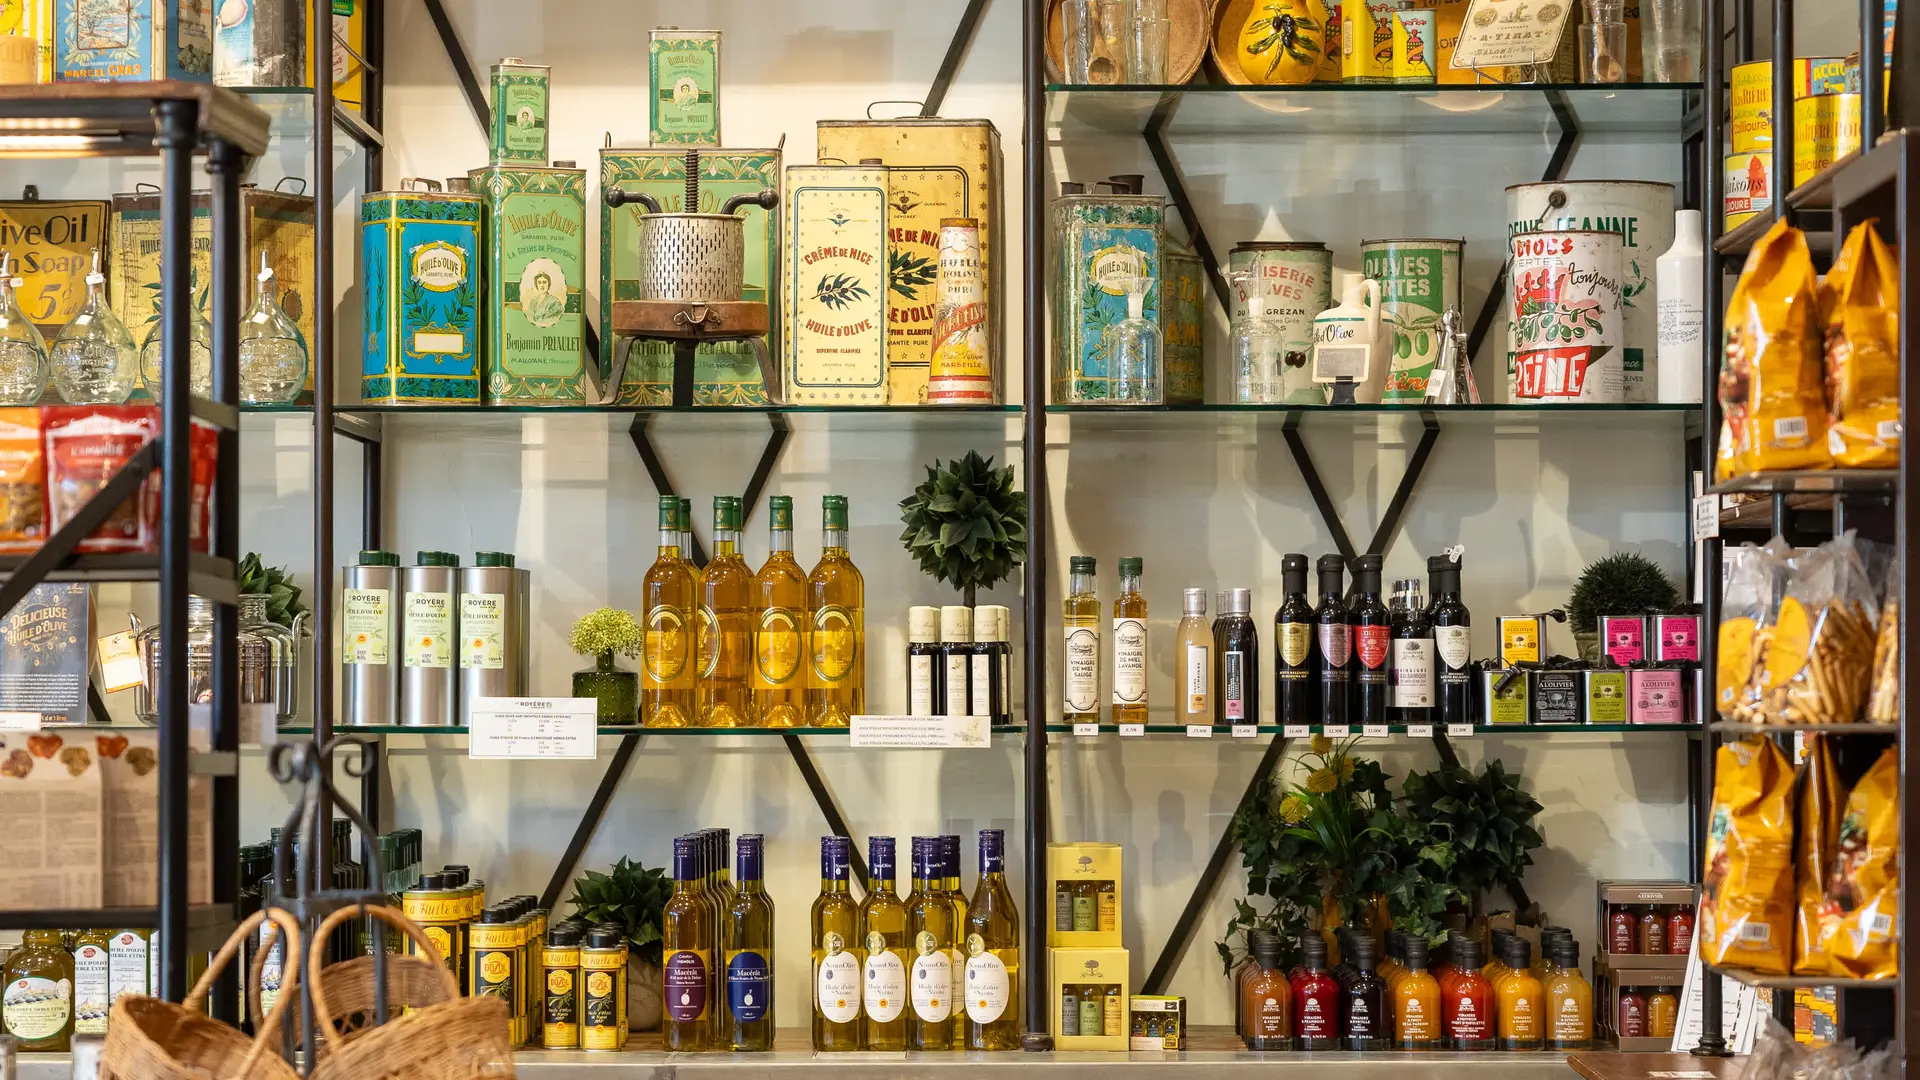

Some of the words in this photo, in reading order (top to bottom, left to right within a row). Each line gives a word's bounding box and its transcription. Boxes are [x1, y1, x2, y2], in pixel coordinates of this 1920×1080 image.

[64, 69, 105, 78] MARCEL
[108, 64, 142, 76] GRAS
[44, 214, 88, 245] Oil
[508, 212, 540, 235] HUILE
[905, 229, 917, 243] DE
[24, 251, 84, 276] Soap
[420, 257, 437, 275] HUILE
[805, 247, 838, 265] CRÊME
[839, 248, 849, 256] DE
[850, 249, 873, 266] NICE
[941, 258, 980, 268] HUILE
[1366, 255, 1430, 277] OLIVES
[1098, 260, 1116, 276] HUILE
[1568, 262, 1623, 297] toujours
[1266, 308, 1305, 316] GREZAN
[806, 318, 836, 337] HUILE
[837, 319, 872, 337] D'OLIVE
[506, 332, 540, 353] Benjamin
[542, 337, 580, 352] PRIAULET
[940, 361, 982, 369] MARSEILLE
[1516, 353, 1586, 396] REINE
[10, 605, 68, 630] DÉLICIEUSE
[5, 629, 35, 647] HUILE
[35, 620, 68, 638] D'OLIVE
